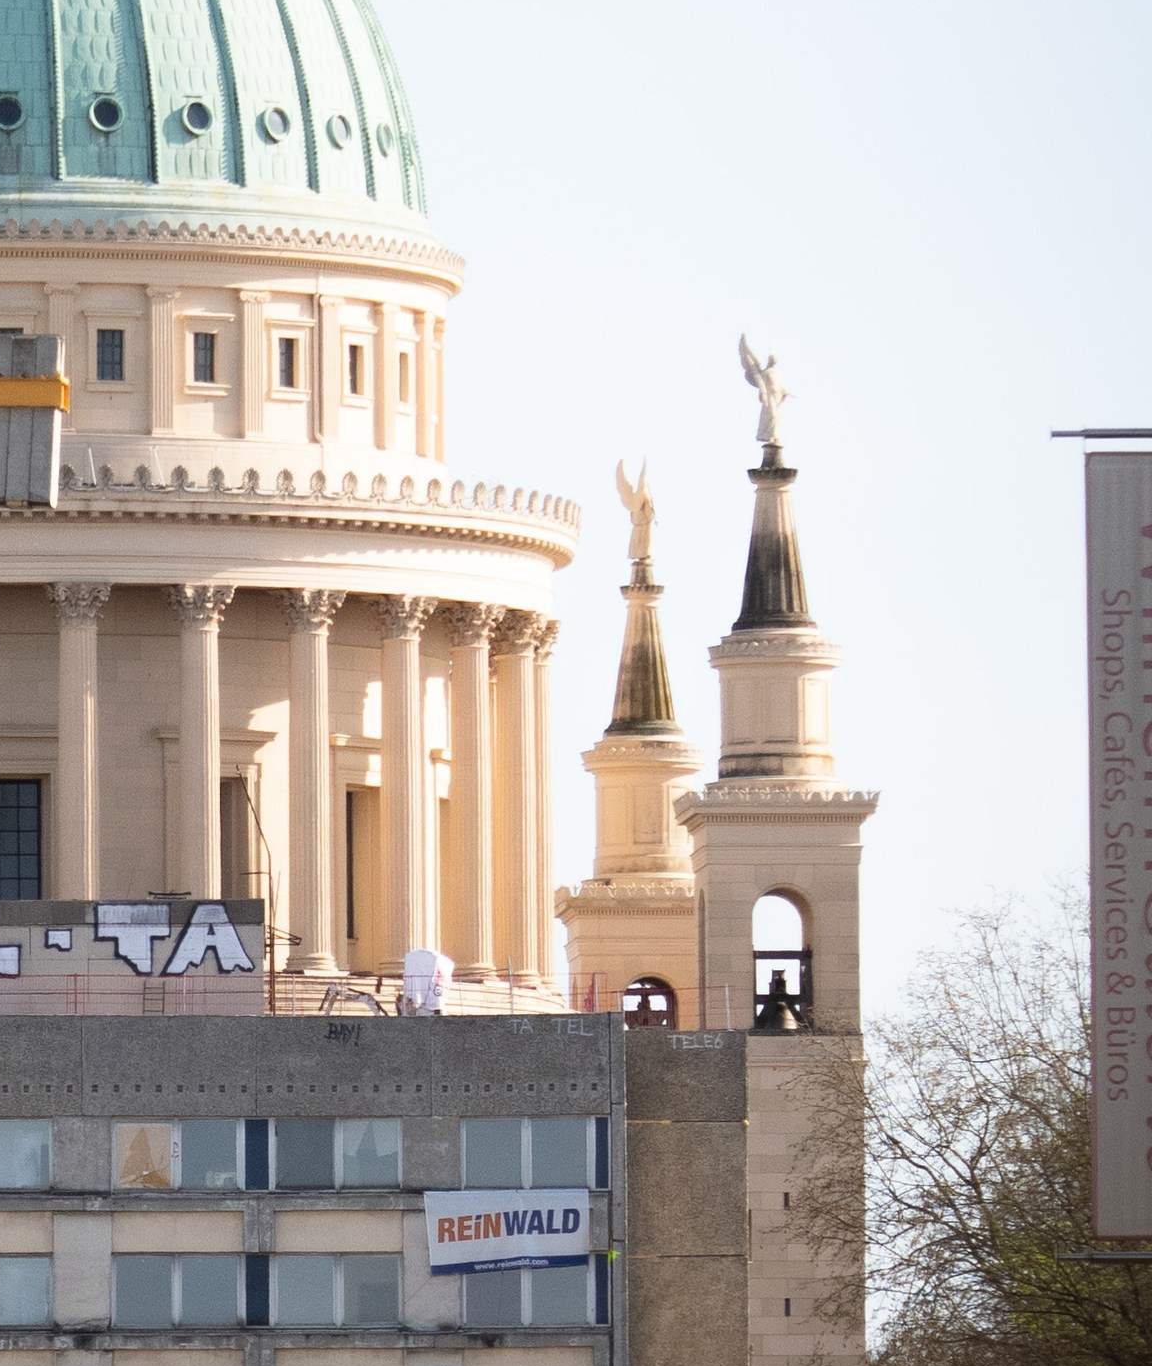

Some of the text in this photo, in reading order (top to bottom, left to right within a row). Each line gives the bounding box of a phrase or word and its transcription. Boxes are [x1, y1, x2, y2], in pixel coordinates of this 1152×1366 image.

[1095, 589, 1137, 1102] Shops, Cafés, Services & Büros
[551, 1017, 594, 1036] TEL
